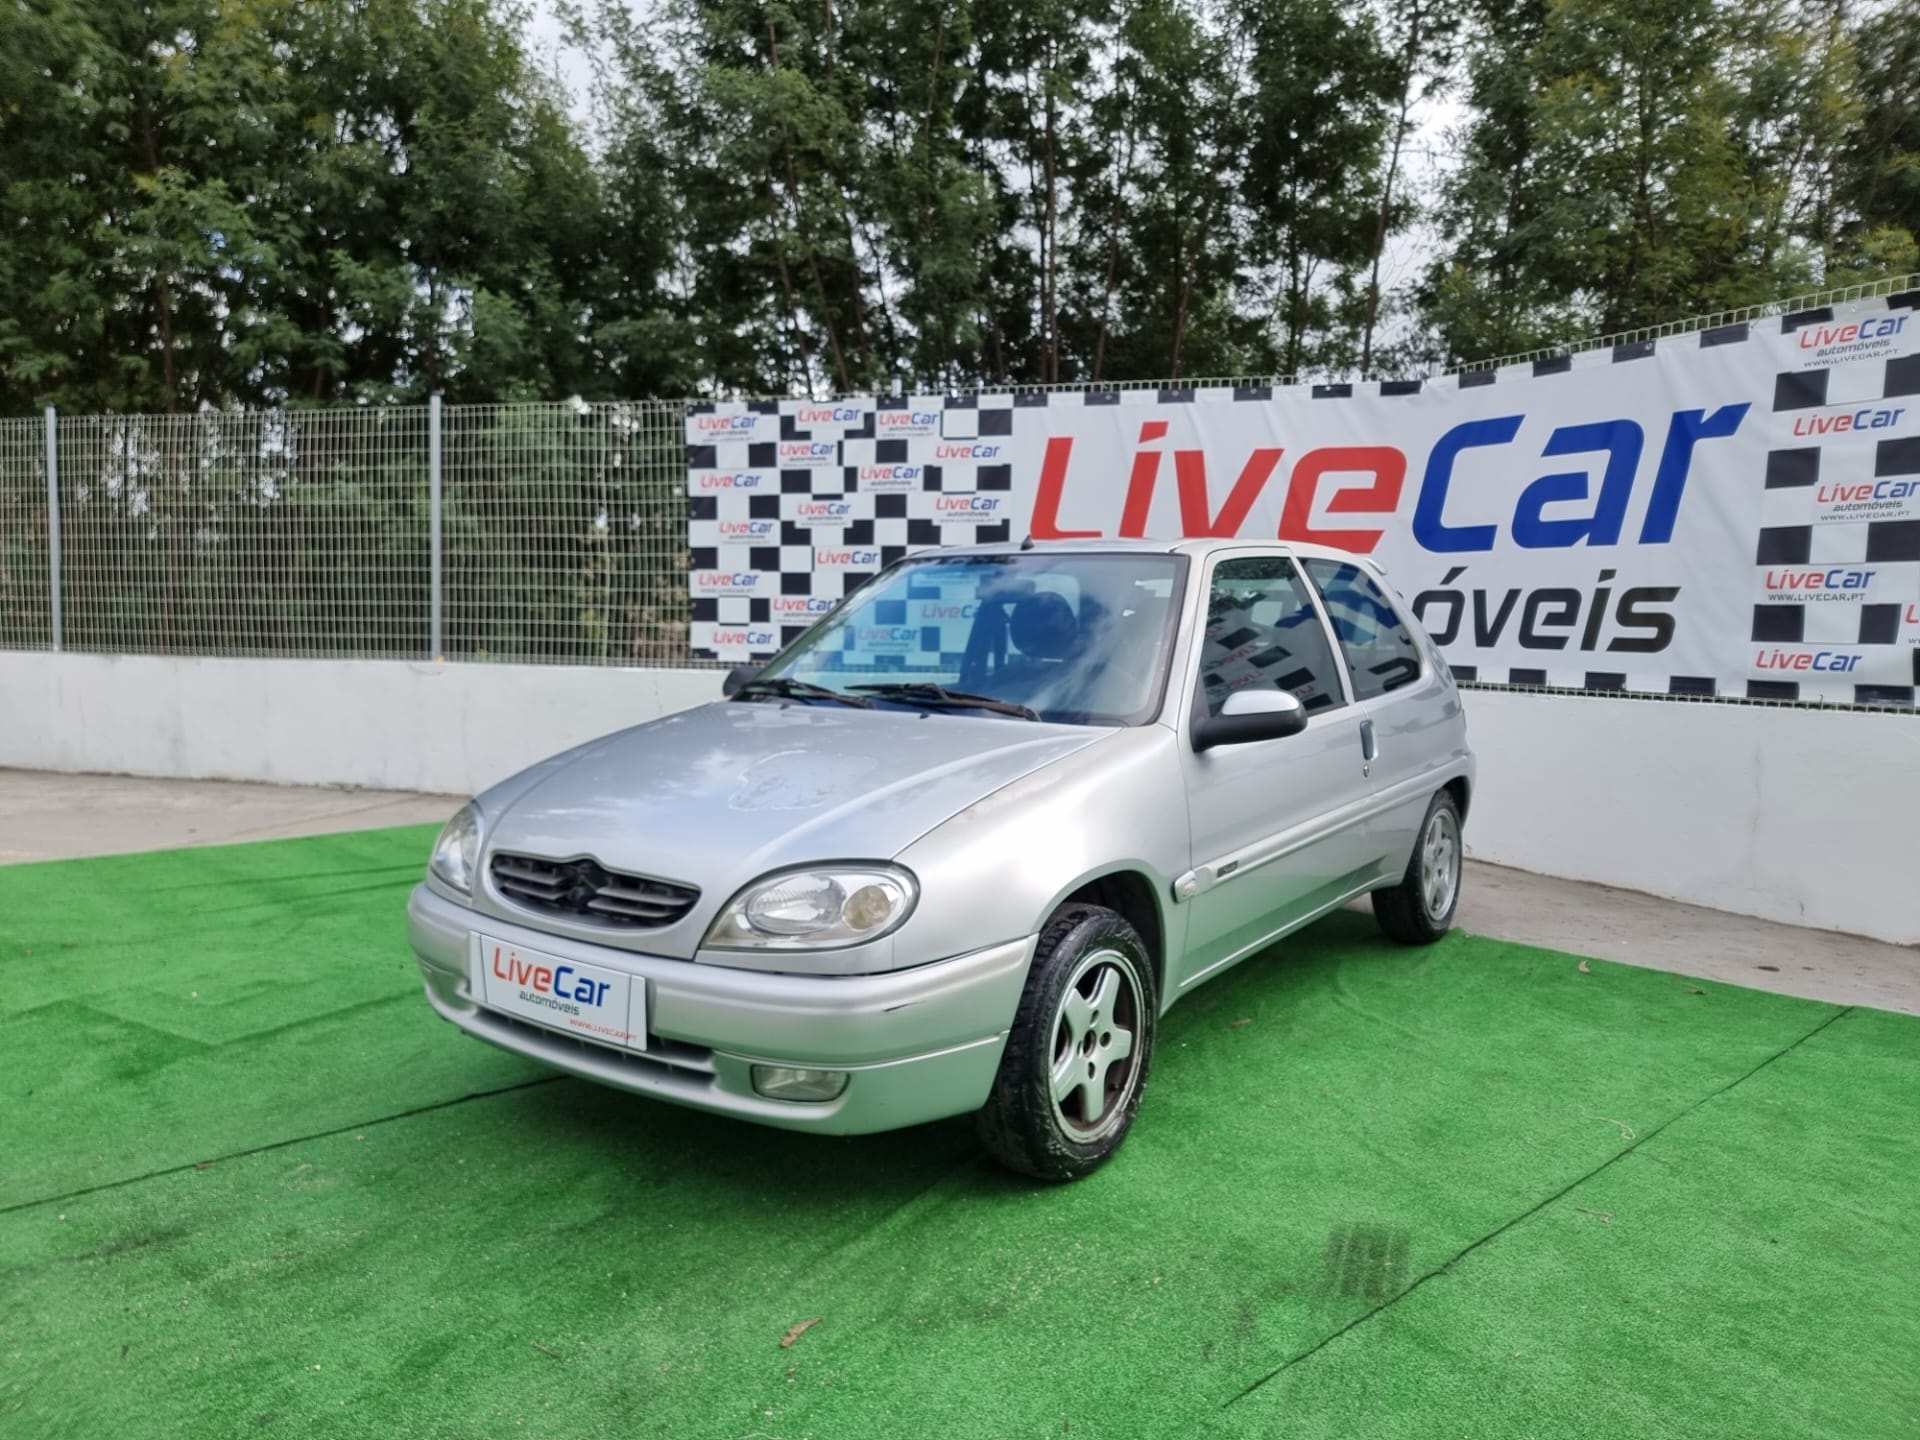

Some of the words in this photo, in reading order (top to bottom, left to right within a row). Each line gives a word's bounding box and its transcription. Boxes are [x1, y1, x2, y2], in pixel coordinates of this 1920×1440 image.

[1800, 315, 1908, 349] LiveCar
[798, 408, 861, 422] LiveCar
[879, 412, 938, 426] LiveCar
[1793, 408, 1905, 436] LiveCar
[698, 415, 758, 430] LiveCar
[779, 443, 834, 456] LiveCar
[936, 445, 1000, 458] LiveCar
[861, 466, 921, 480] LiveCar
[1029, 402, 1752, 553] LiveCar
[701, 474, 762, 488] LiveCar
[1817, 480, 1920, 503] LiveCar
[797, 503, 851, 515] LiveCar
[936, 497, 1000, 510] LiveCar
[1833, 500, 1903, 512] automóveis
[719, 521, 774, 533] LiveCar
[817, 551, 878, 564] LiveCar
[699, 573, 759, 586] LiveCar
[1765, 569, 1876, 590] LiveCar
[1768, 593, 1866, 601] WWW.LIVECAR.PT
[773, 598, 833, 612] LiveCar
[1411, 566, 1681, 654] óveis
[713, 631, 773, 645] LiveCar
[1756, 649, 1862, 672] LiveCar
[493, 947, 611, 1008] LiveCar
[519, 990, 580, 1016] automóveis
